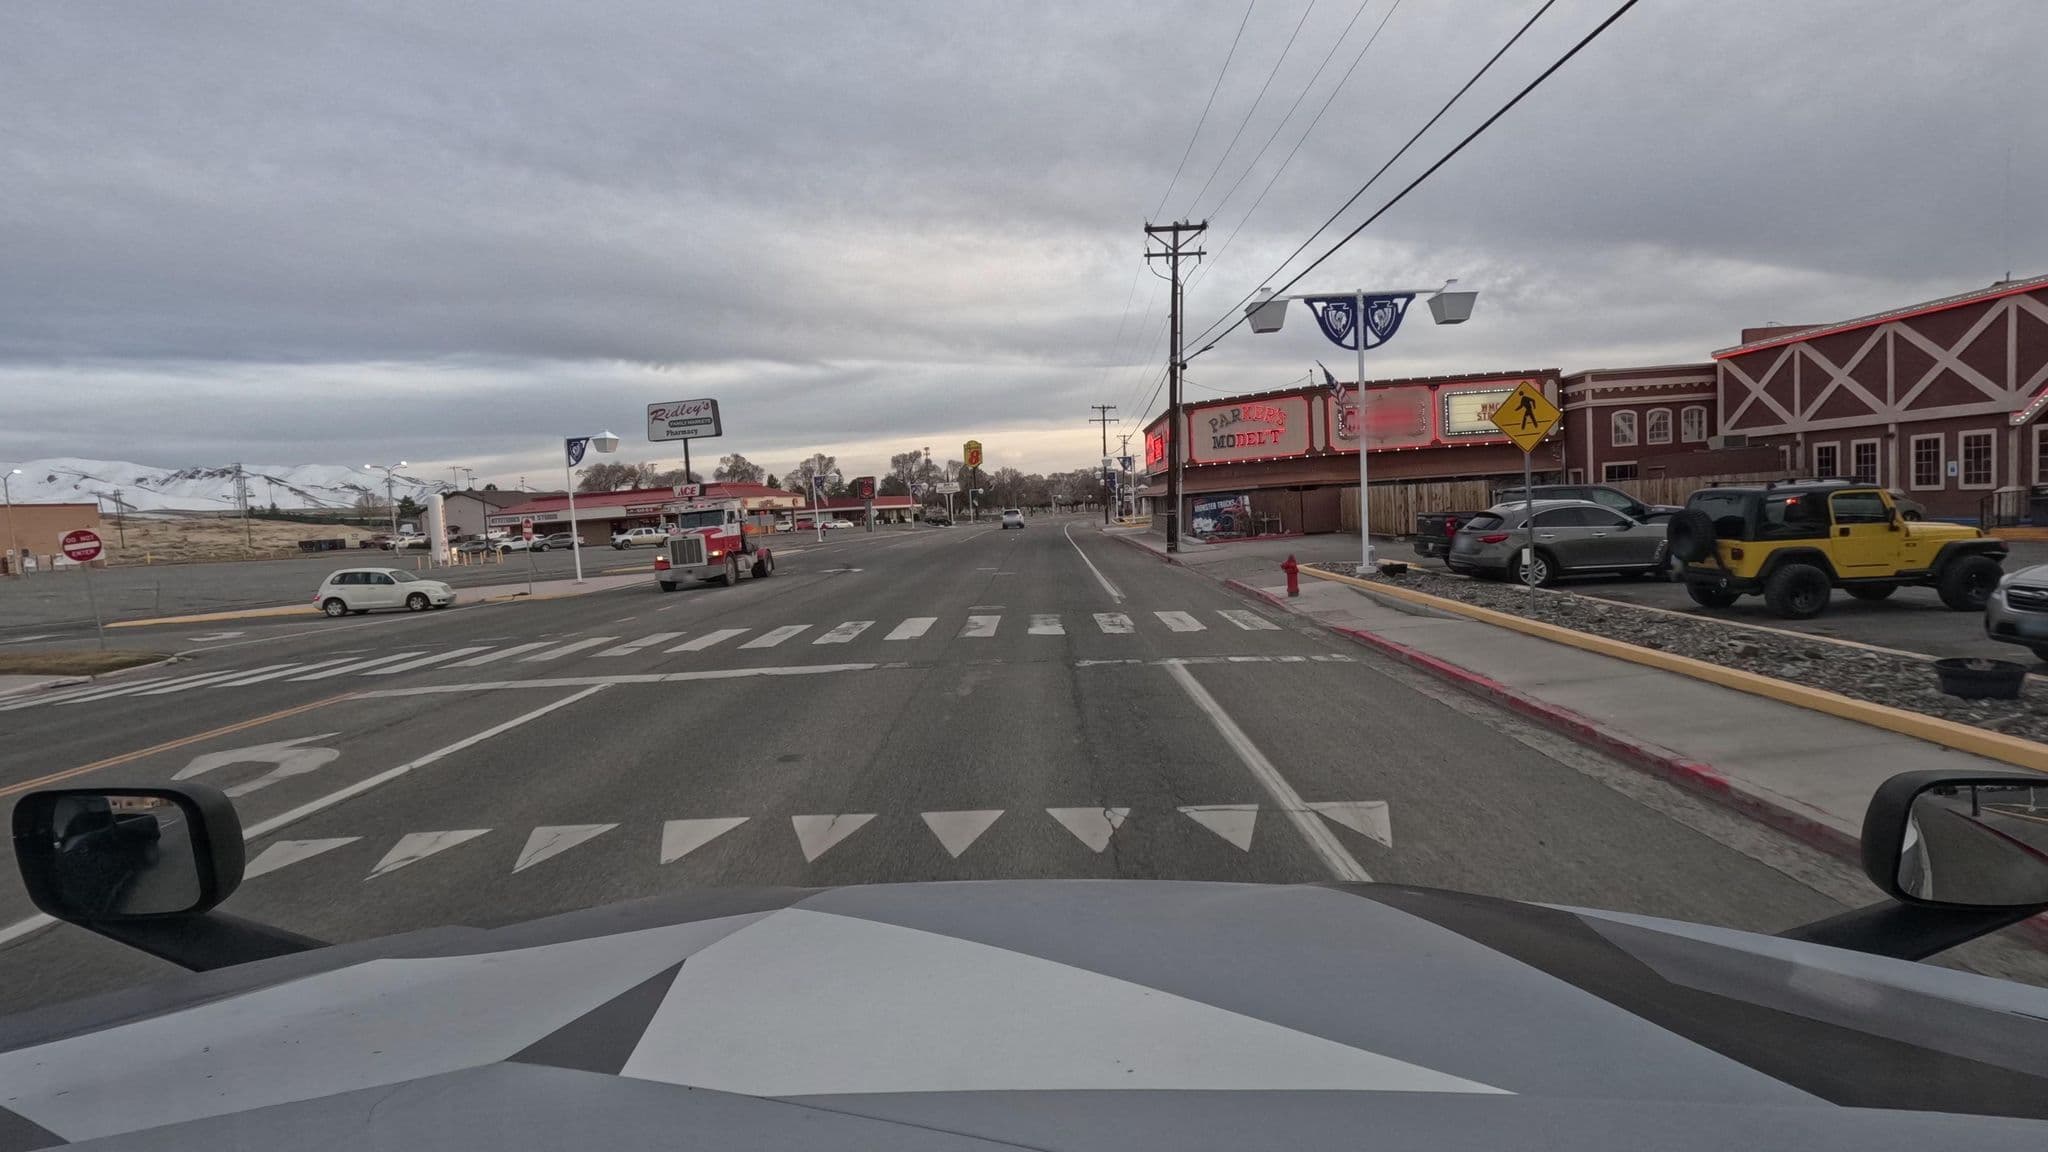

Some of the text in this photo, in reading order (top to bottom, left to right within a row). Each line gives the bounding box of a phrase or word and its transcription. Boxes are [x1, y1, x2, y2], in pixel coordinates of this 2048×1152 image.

[650, 402, 709, 424] Ridley's
[1208, 406, 1286, 433] PARKER'S
[1212, 430, 1280, 449] MODEL T
[678, 487, 696, 496] ACE
